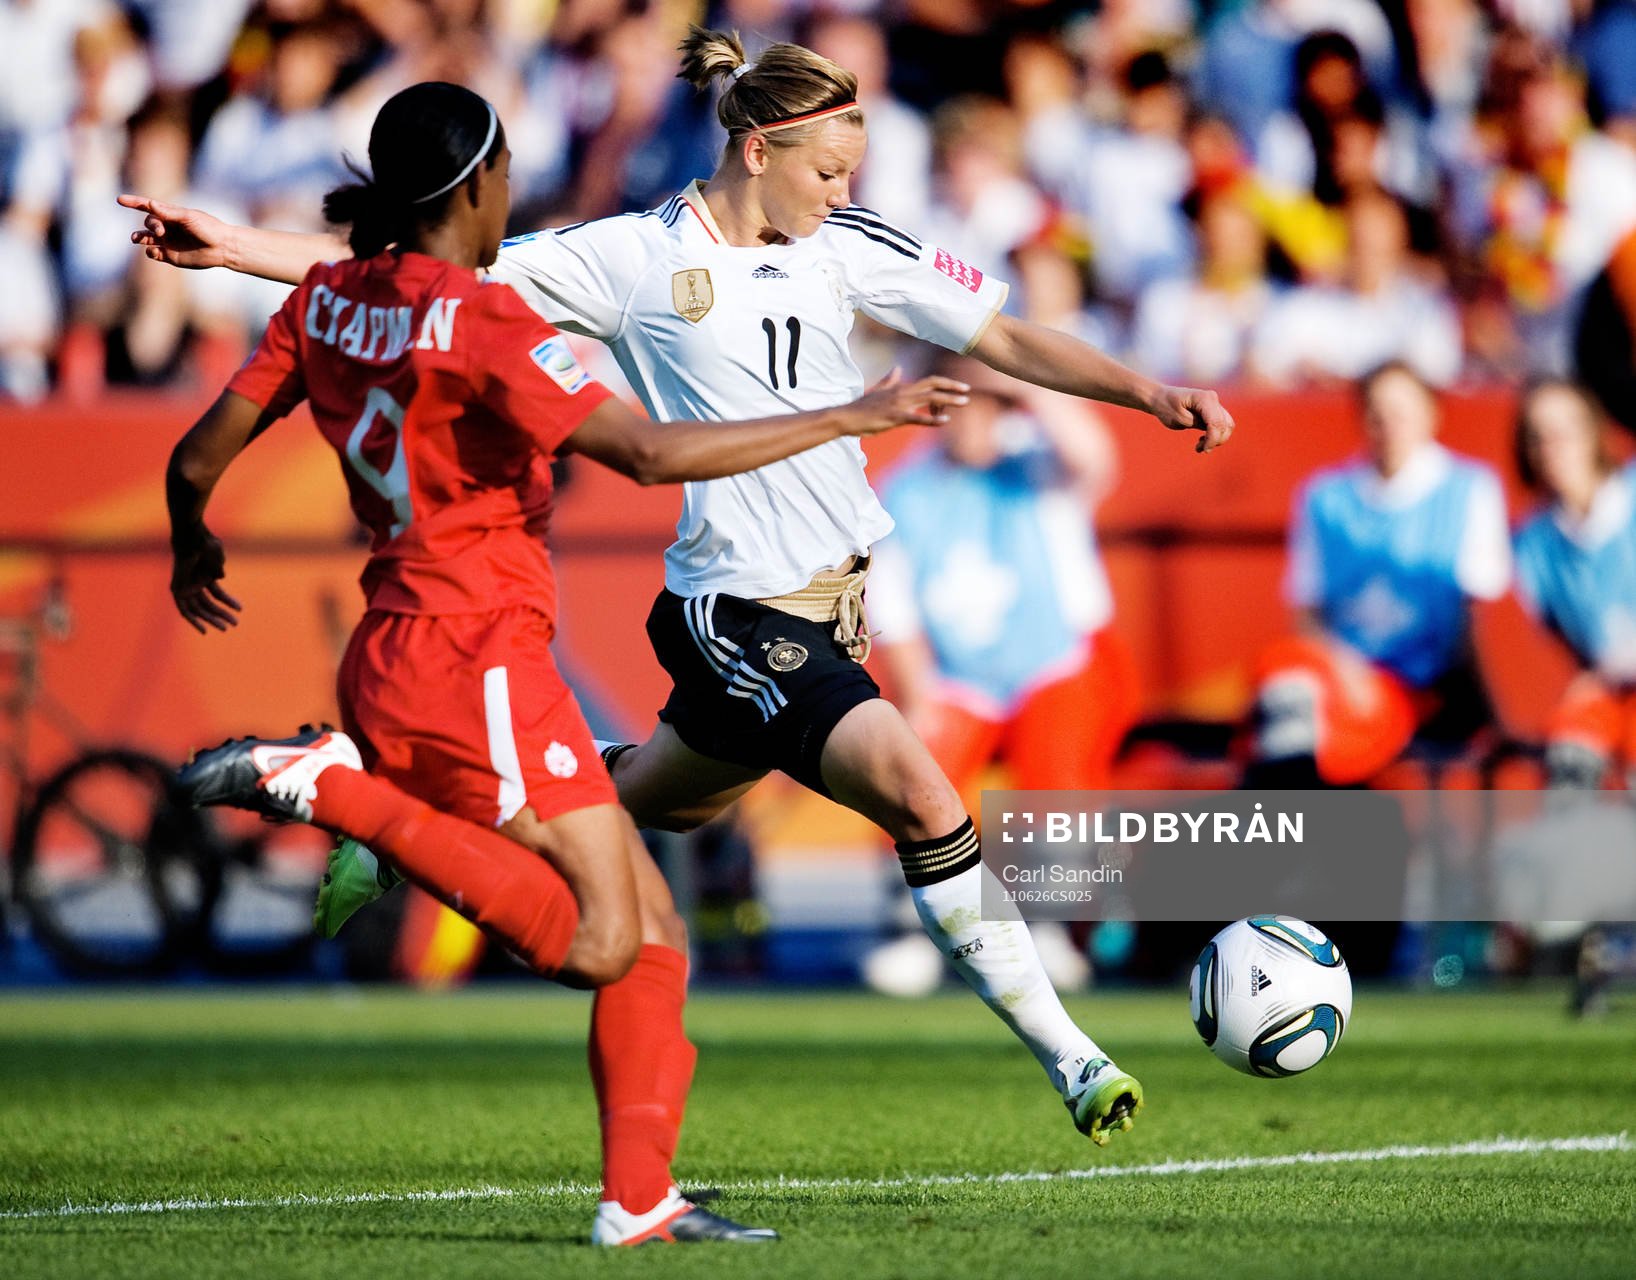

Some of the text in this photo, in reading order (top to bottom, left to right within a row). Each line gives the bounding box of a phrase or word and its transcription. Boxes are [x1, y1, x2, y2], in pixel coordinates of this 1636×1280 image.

[685, 301, 704, 310] FIFA
[762, 316, 801, 390] 11
[346, 386, 413, 540] 9
